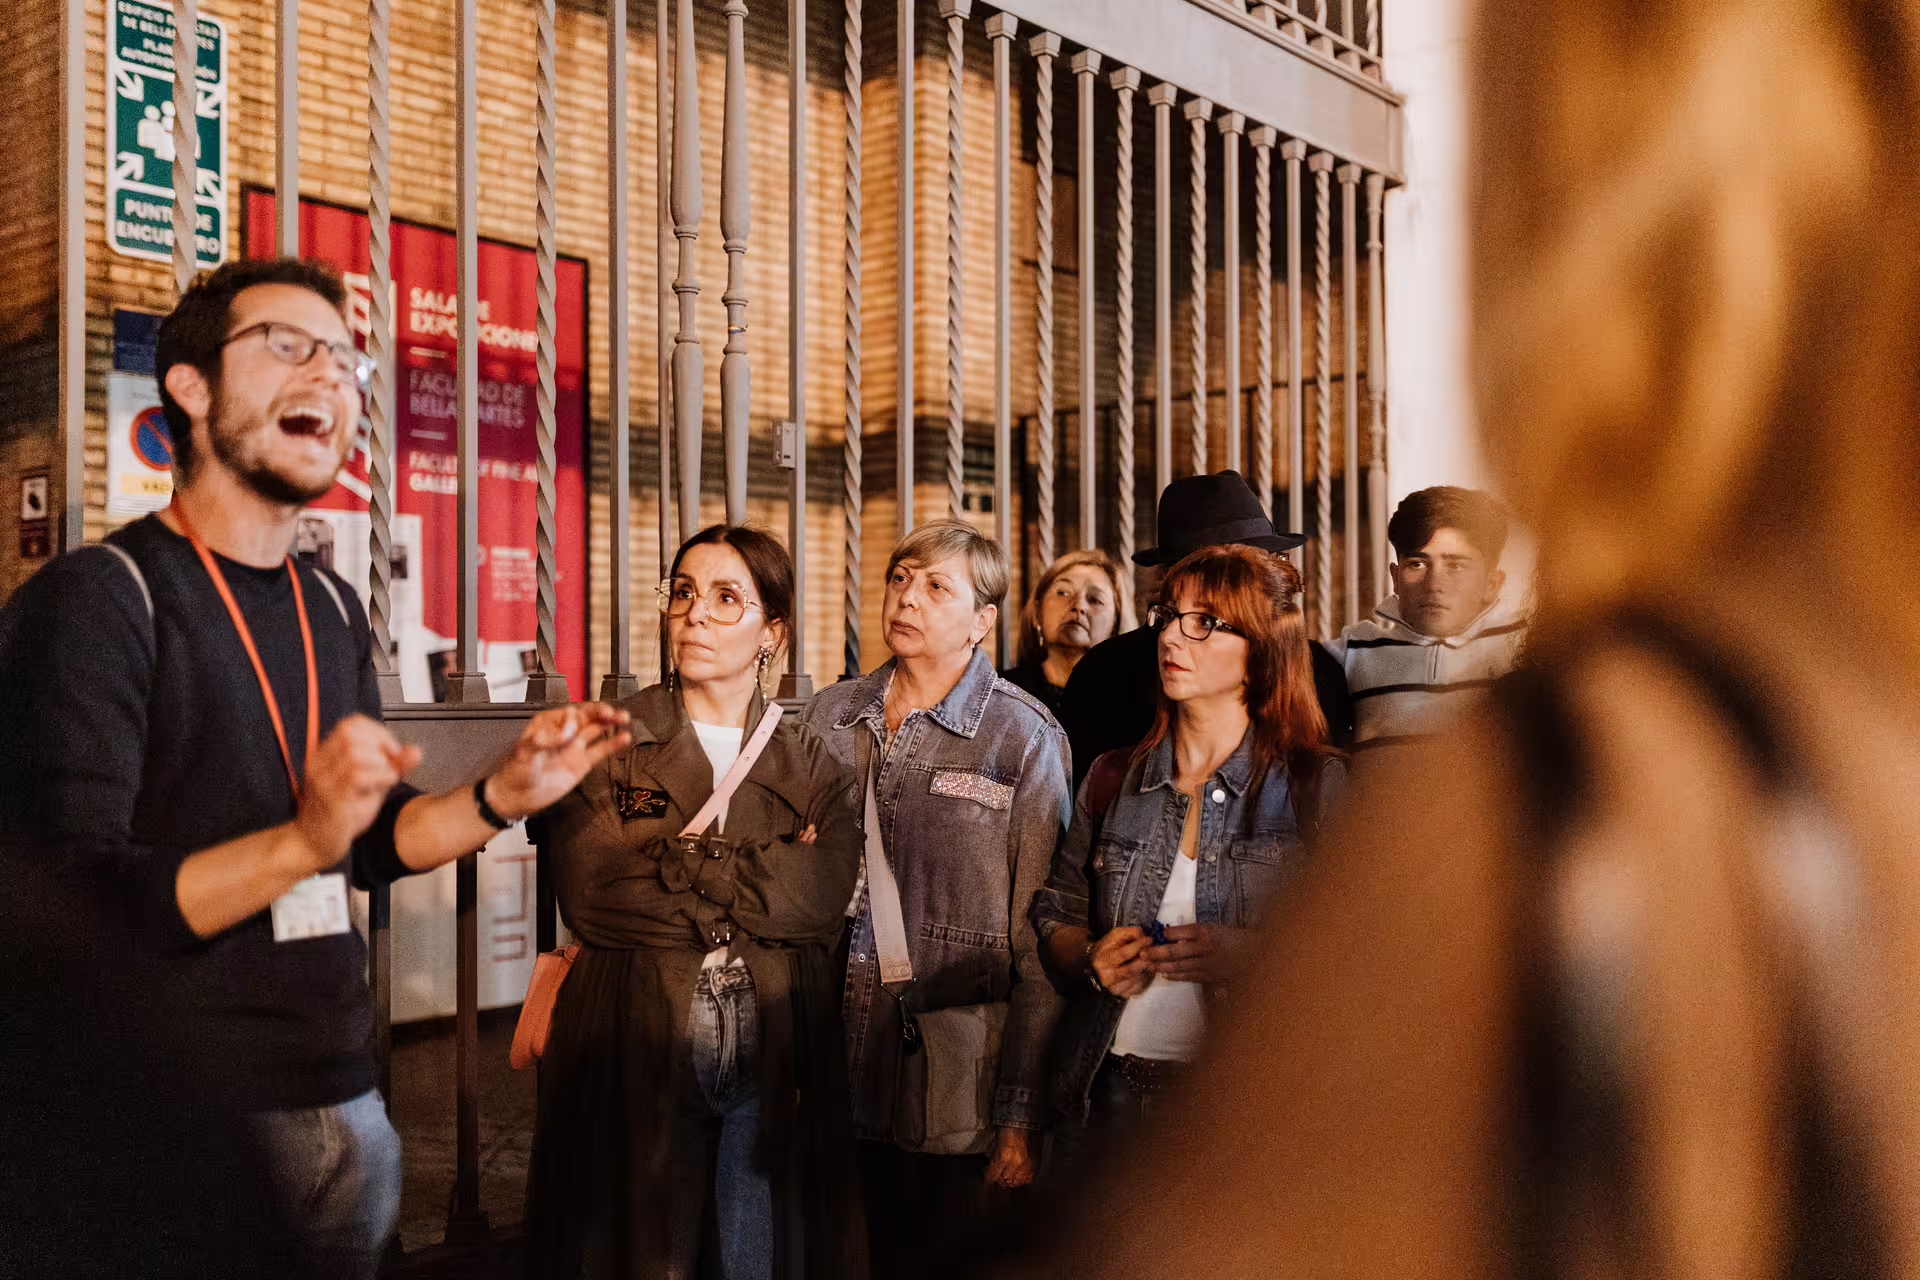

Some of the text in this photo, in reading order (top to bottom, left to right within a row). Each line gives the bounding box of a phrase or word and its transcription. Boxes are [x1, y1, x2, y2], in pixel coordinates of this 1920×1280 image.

[140, 20, 176, 40] BELLA
[124, 199, 173, 223] PUNT
[115, 219, 219, 255] ENCUERO
[410, 310, 538, 353] EXPOCIONE
[410, 369, 499, 402] FACUAD
[410, 392, 458, 420] BELLA
[409, 472, 458, 495] GALLE
